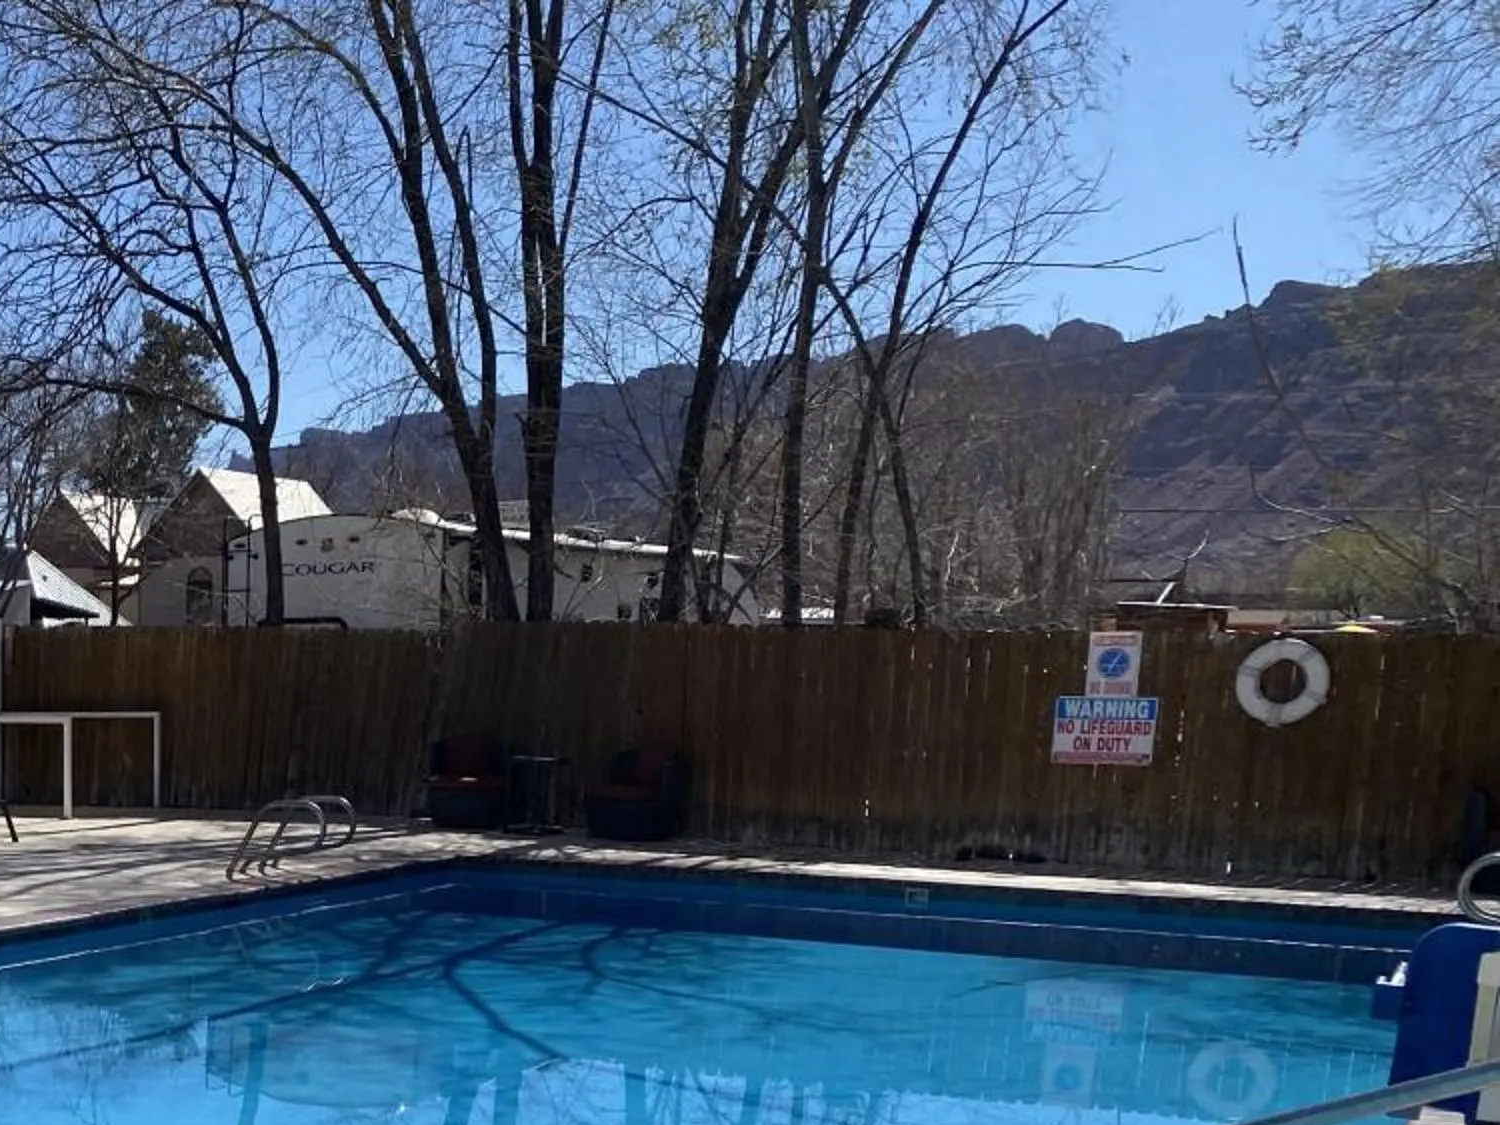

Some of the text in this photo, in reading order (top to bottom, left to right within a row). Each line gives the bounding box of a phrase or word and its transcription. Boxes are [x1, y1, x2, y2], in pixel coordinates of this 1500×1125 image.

[282, 562, 376, 577] COUGAR
[1065, 699, 1150, 719] WARNING
[1057, 719, 1152, 736] NO LIFEGUARD
[1073, 736, 1131, 752] ON DUTY
